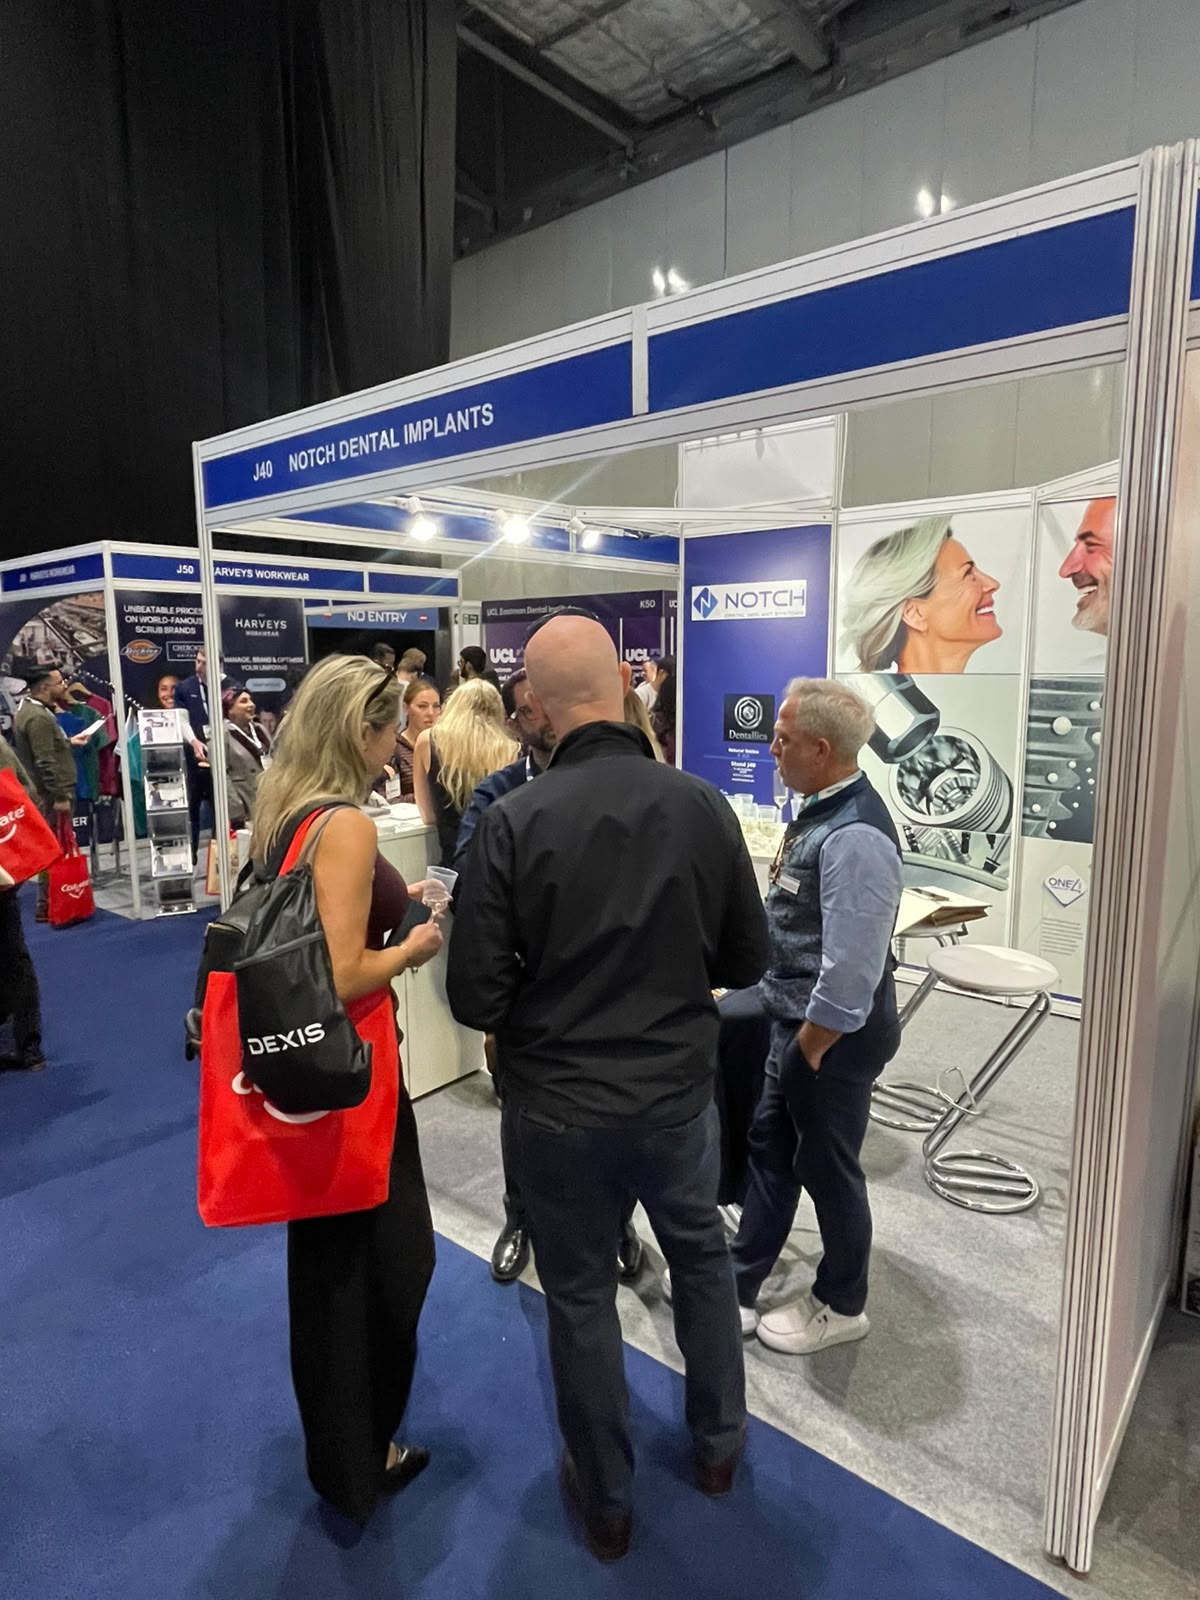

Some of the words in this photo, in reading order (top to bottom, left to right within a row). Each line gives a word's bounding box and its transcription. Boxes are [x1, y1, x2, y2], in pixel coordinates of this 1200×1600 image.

[253, 460, 273, 481] J40
[288, 443, 335, 472] NOTCH
[339, 428, 400, 461] DENTAL
[403, 402, 494, 445] IMPLANTS
[176, 565, 195, 575] J50
[255, 569, 310, 582] WORKWEAR
[640, 600, 656, 609] K50
[668, 600, 678, 608] UC
[725, 589, 805, 609] NOTCH
[123, 605, 174, 615] UNBEATABLE
[486, 608, 499, 617] UCL
[526, 605, 549, 614] Dental
[125, 615, 138, 623] ON
[347, 611, 366, 622] NO
[367, 611, 408, 623] ENTRY
[135, 625, 163, 634] SCRUB
[164, 626, 197, 635] BRANDS
[235, 618, 287, 630] HARVEYS
[489, 648, 517, 664] UCL
[625, 648, 650, 662] UCL
[0, 806, 25, 827] ate
[72, 816, 88, 827] ER
[247, 1022, 326, 1056] DEXIS
